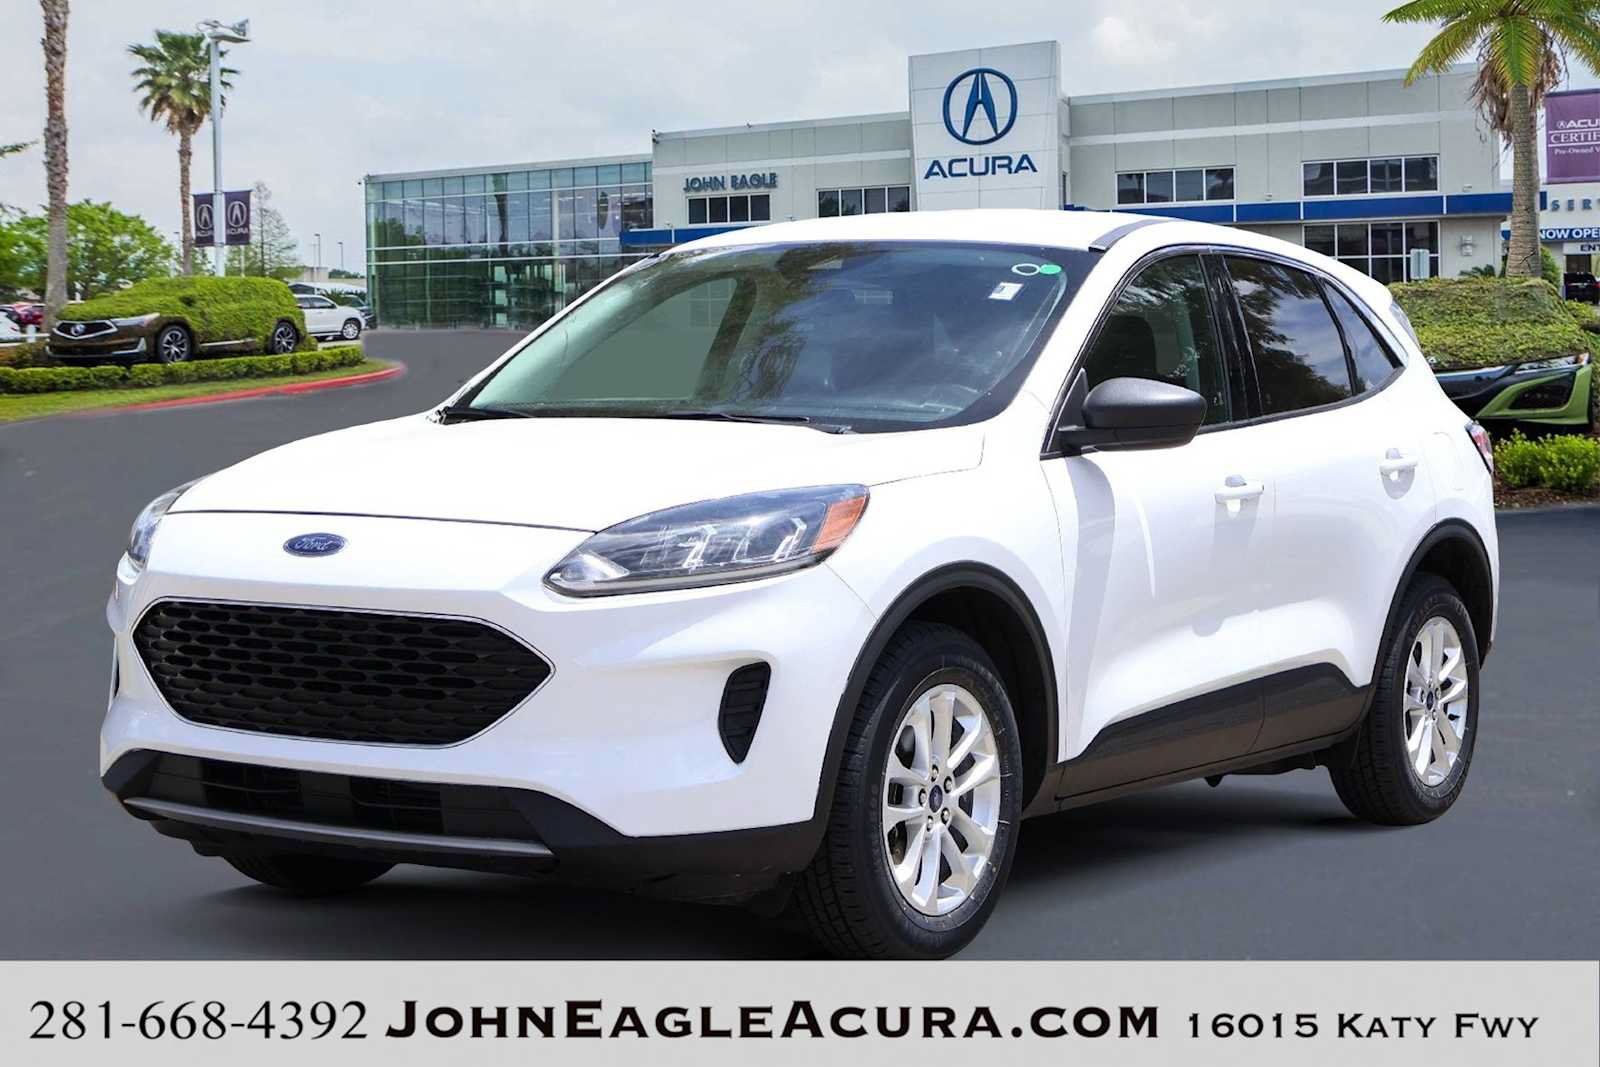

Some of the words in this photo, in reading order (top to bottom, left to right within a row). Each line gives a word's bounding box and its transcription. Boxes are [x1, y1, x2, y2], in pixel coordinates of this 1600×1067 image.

[1567, 118, 1600, 129] ACU
[924, 154, 1038, 179] ACURA
[683, 175, 726, 192] JOHN
[731, 172, 777, 190] EAGLE
[1551, 198, 1600, 211] SER
[1572, 228, 1600, 238] OPE
[290, 535, 338, 552] Ford
